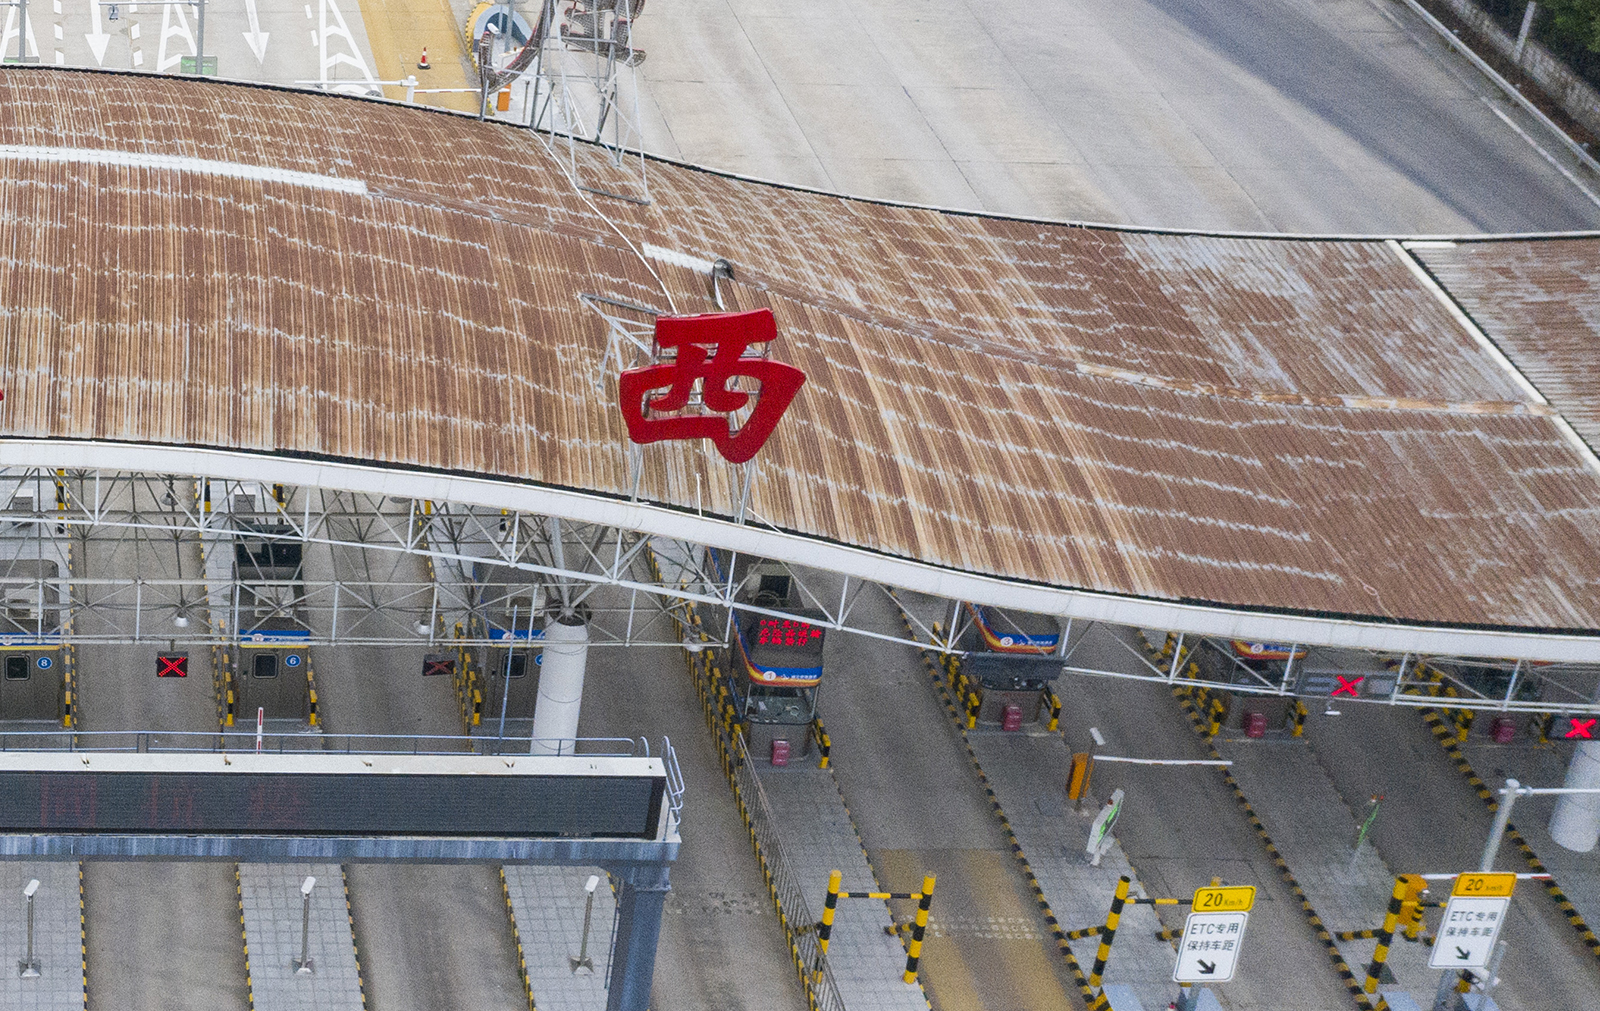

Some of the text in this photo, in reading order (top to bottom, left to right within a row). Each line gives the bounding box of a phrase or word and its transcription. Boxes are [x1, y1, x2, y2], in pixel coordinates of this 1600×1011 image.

[620, 307, 806, 464] 西
[1465, 878, 1484, 891] 20
[1203, 893, 1223, 907] 20
[1450, 911, 1498, 922] ETC专用
[1190, 922, 1239, 935] ETC专用
[1187, 939, 1236, 951] 保持车距
